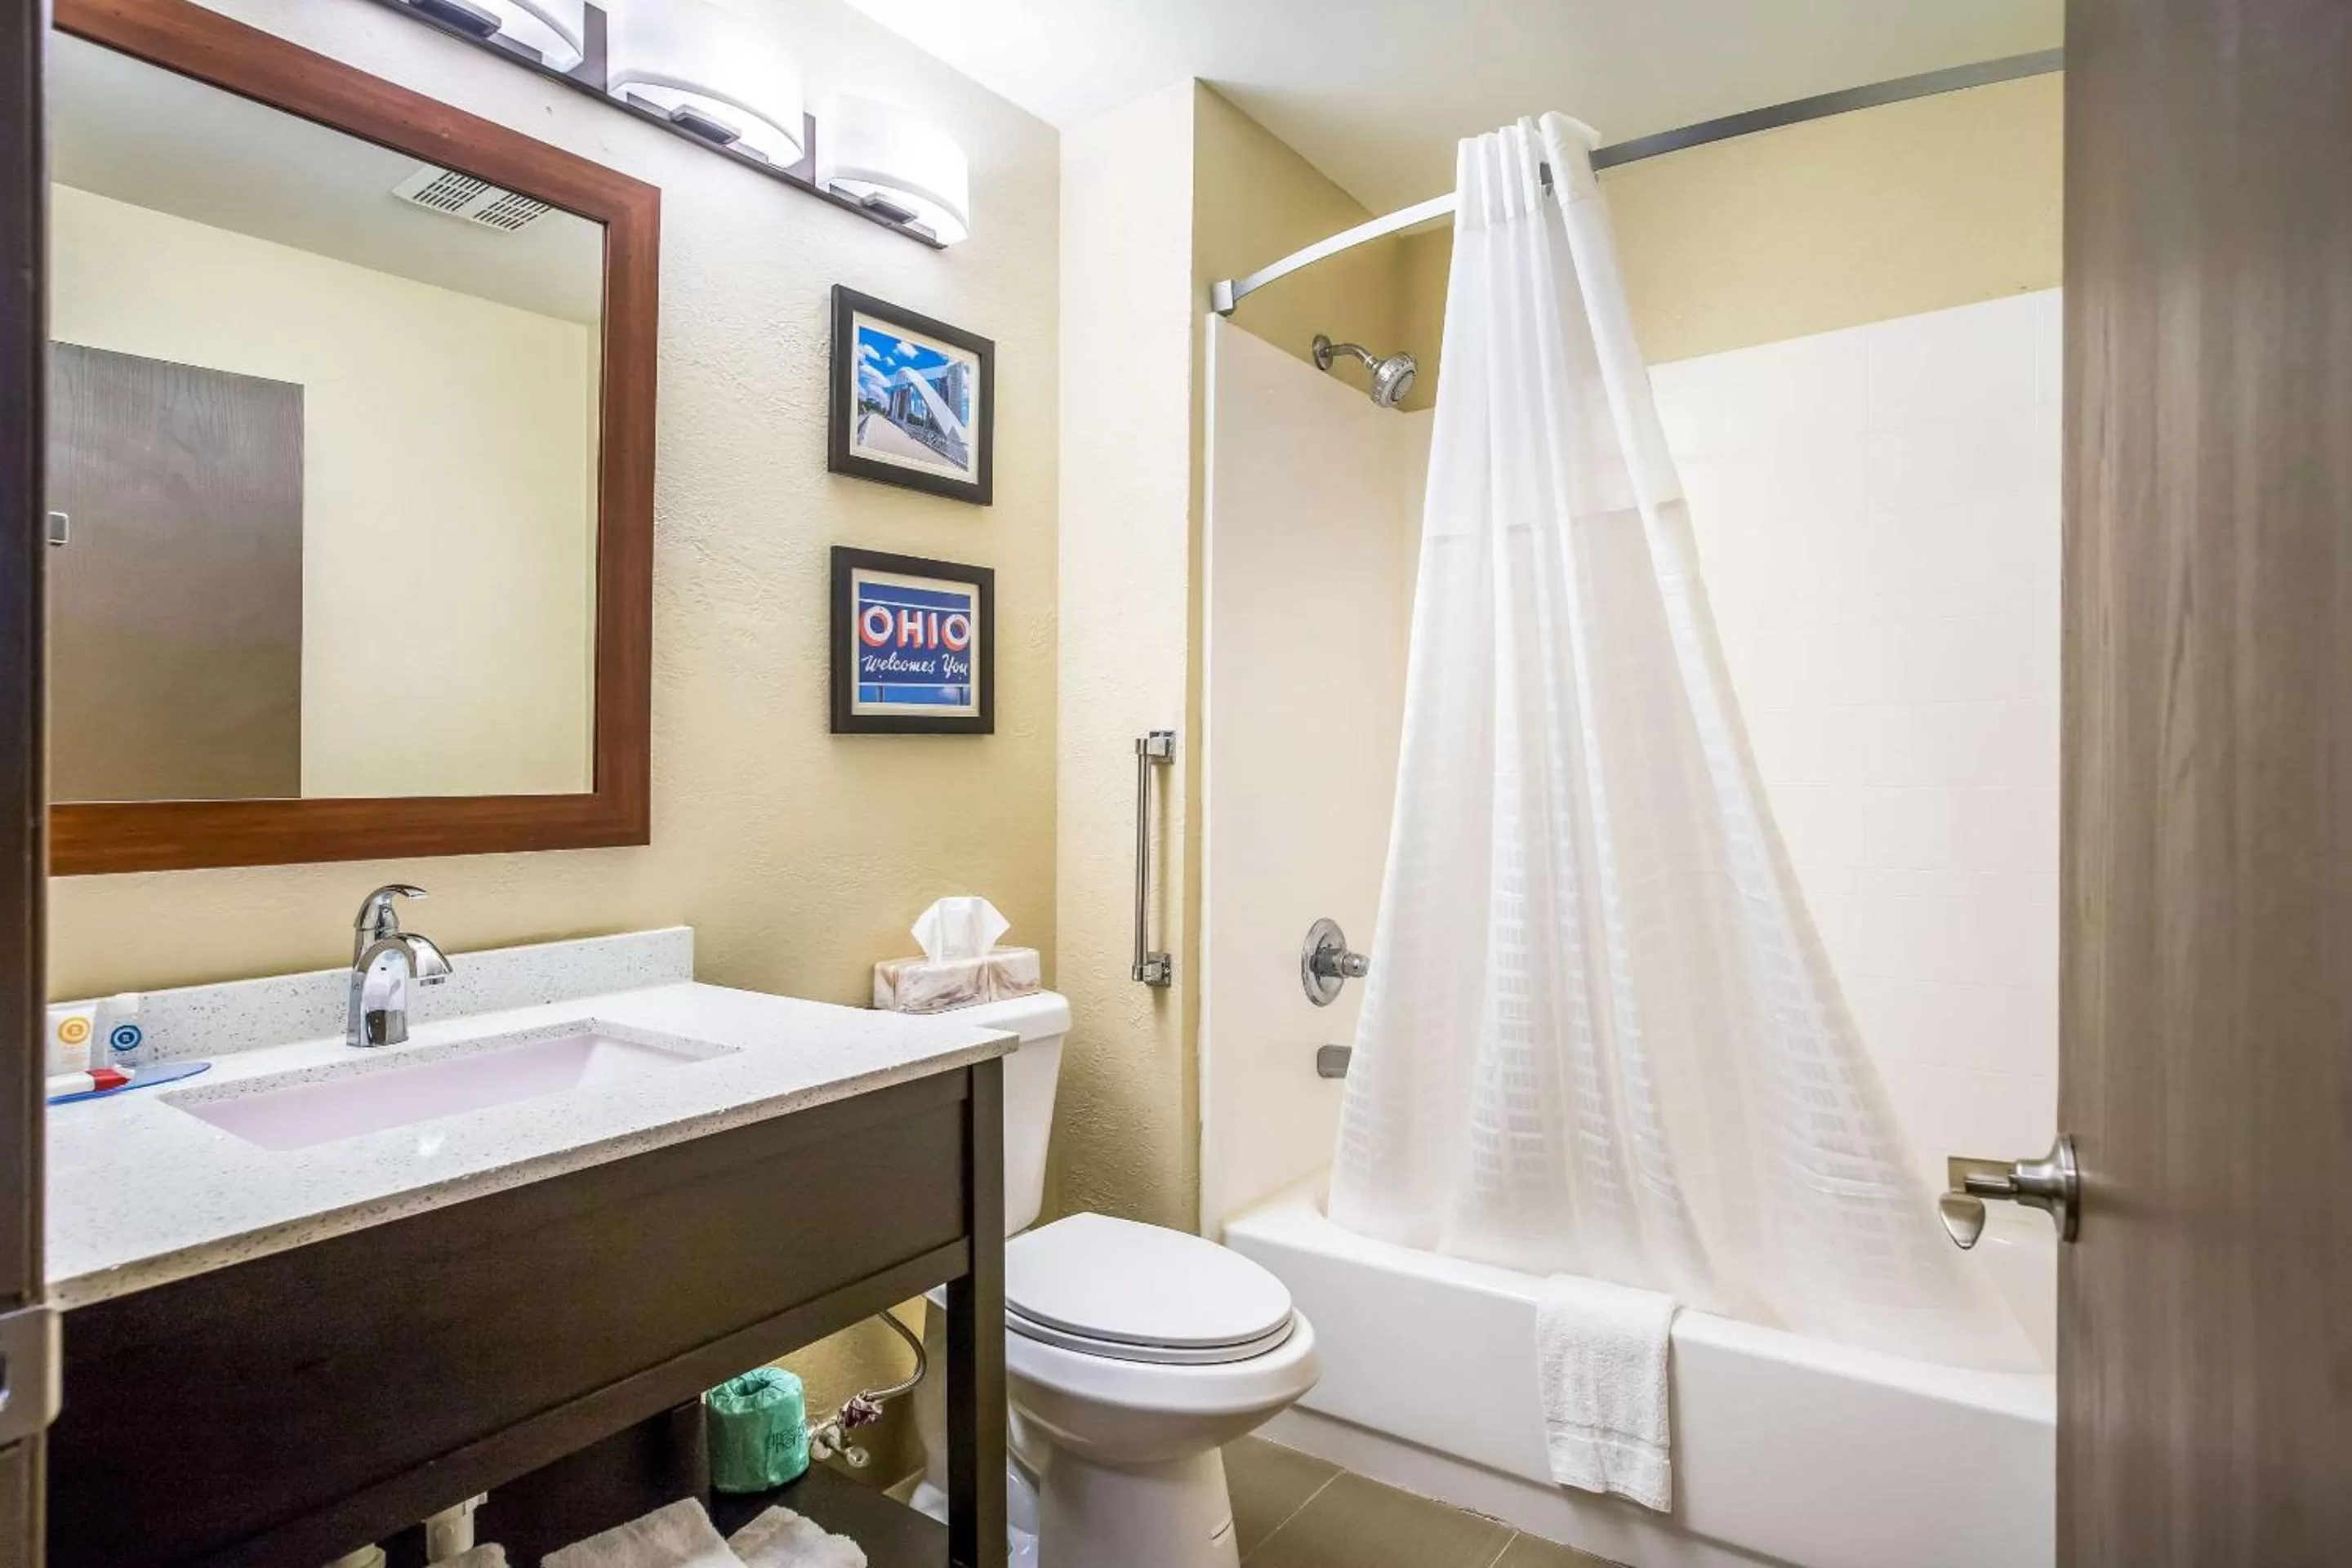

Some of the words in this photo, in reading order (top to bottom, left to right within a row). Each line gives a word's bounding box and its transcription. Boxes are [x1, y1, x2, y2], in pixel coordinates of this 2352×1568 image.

[859, 605, 971, 651] OHIO
[861, 652, 936, 673] Welcomes
[942, 653, 969, 678] You
